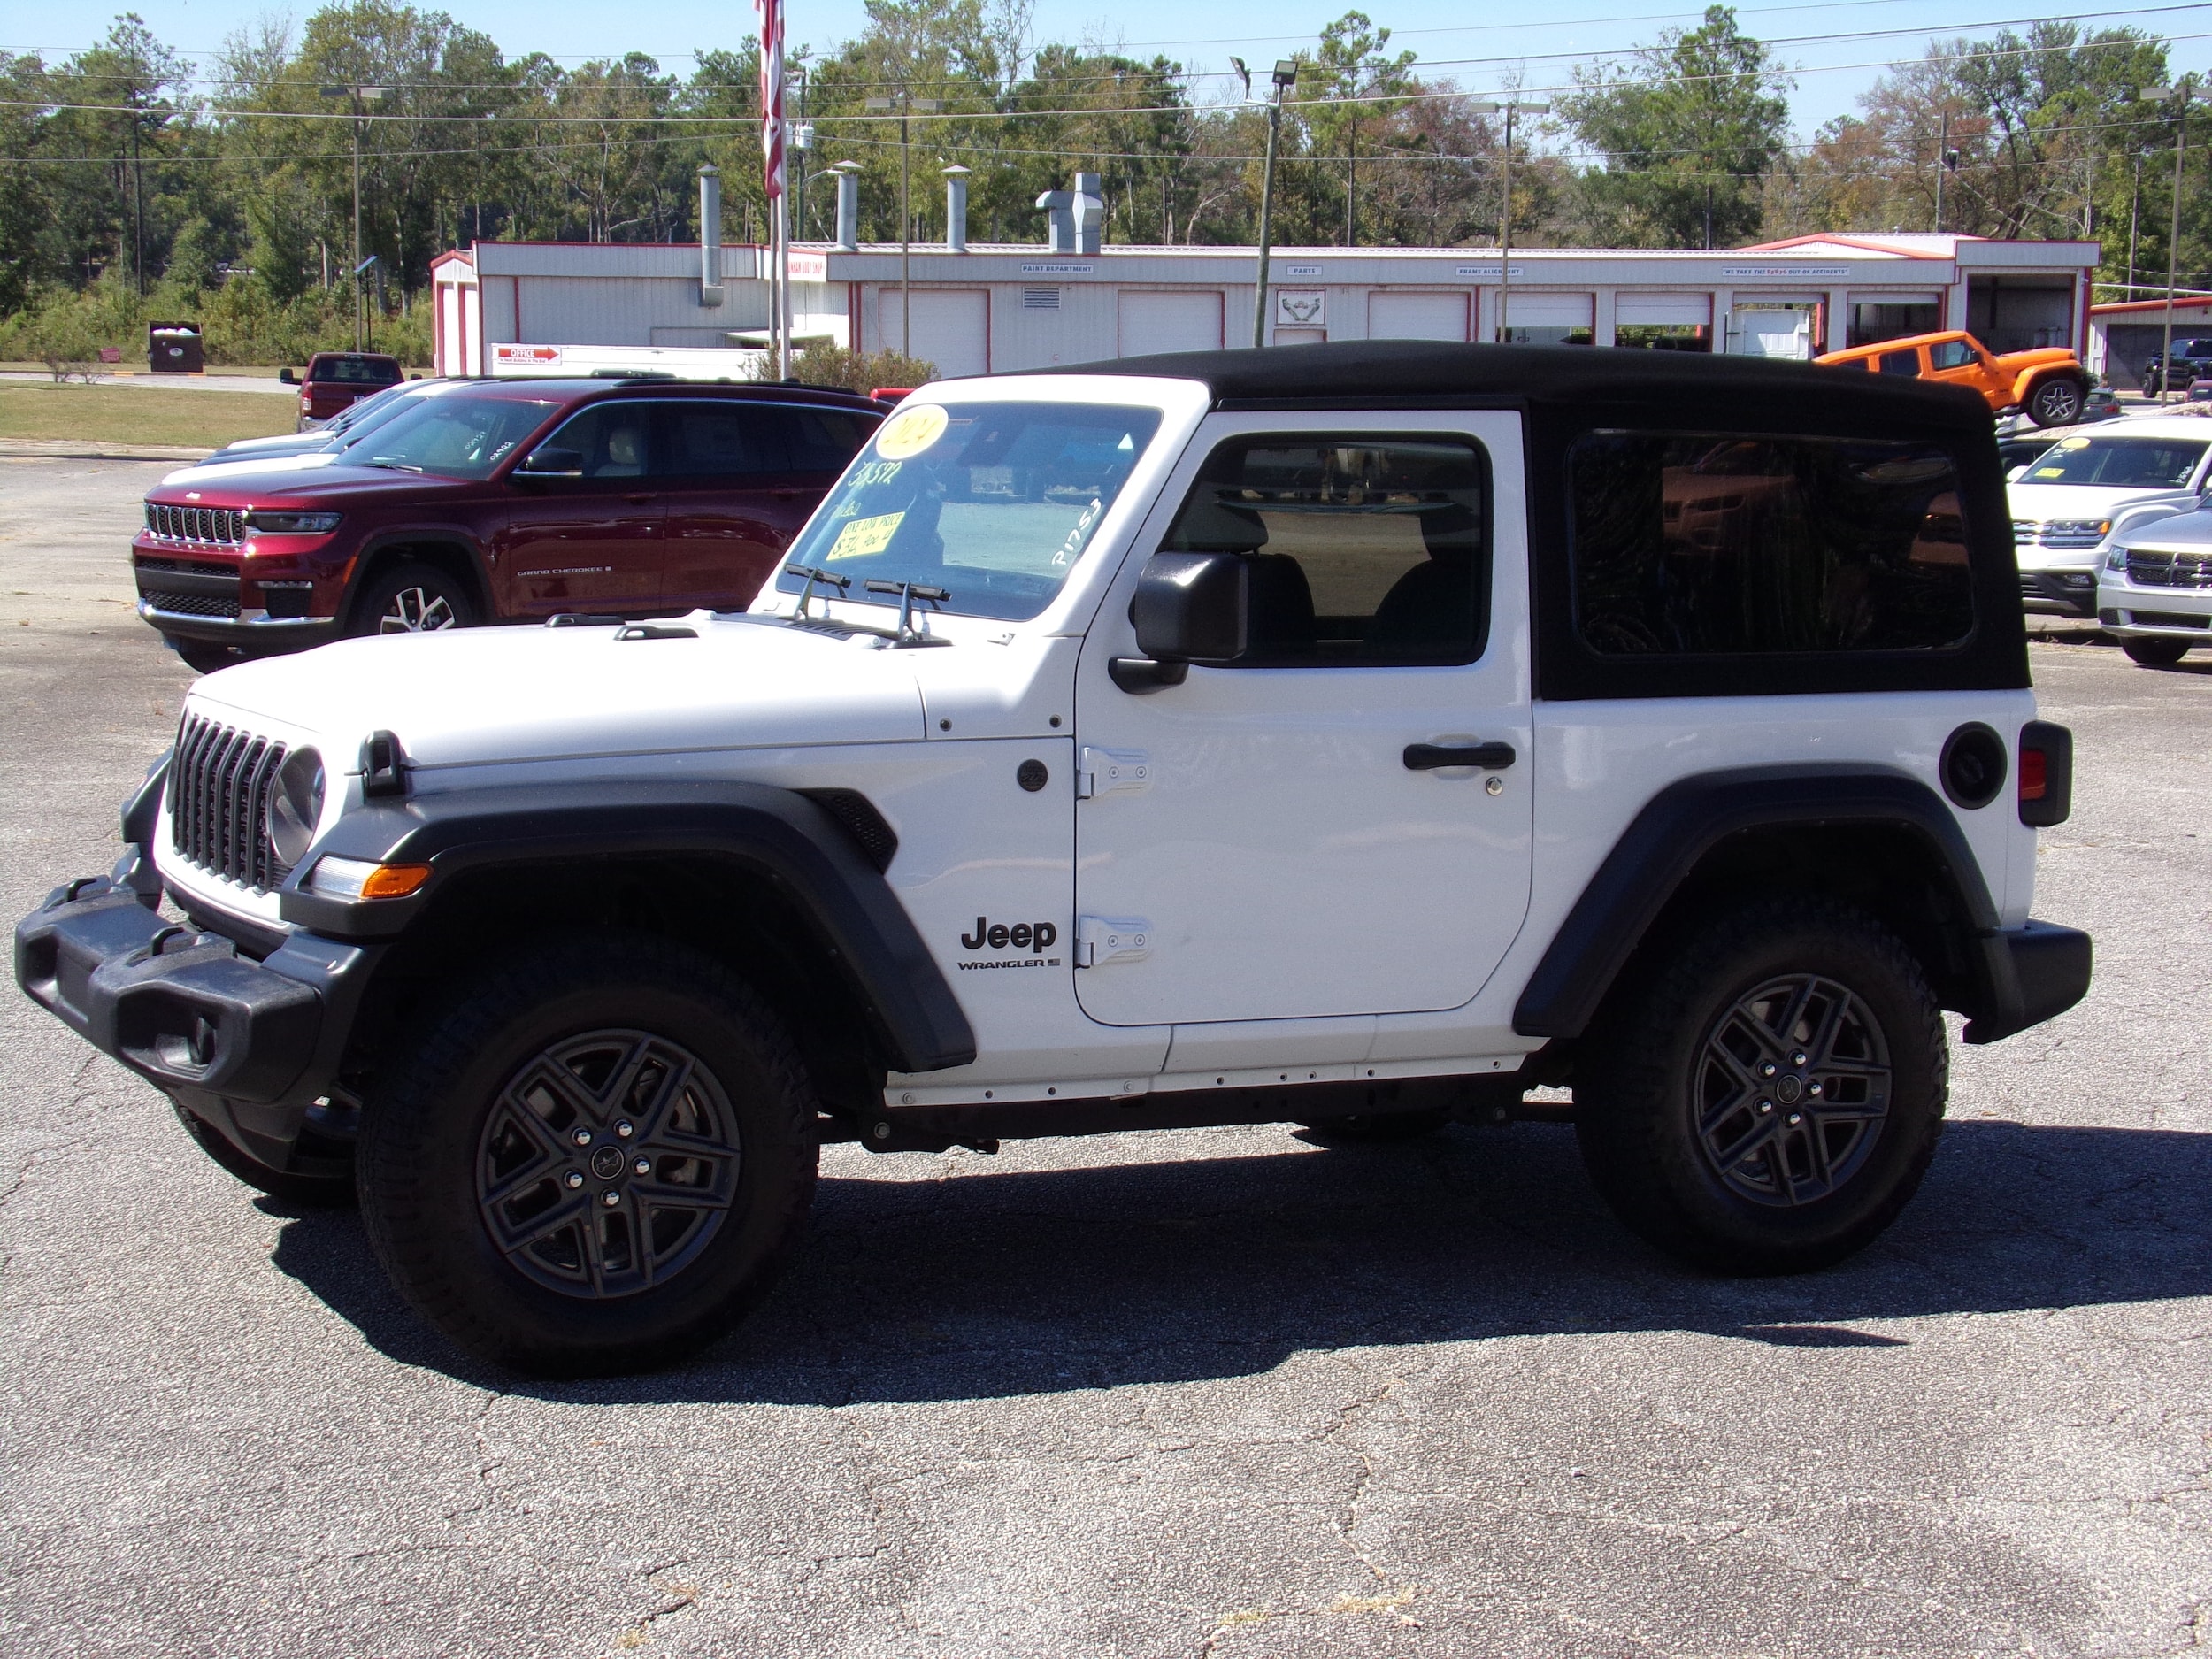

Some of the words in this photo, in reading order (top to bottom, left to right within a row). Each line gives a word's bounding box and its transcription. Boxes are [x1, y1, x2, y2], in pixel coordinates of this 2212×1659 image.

[510, 349, 535, 358] OFFICE
[845, 521, 862, 534] ONE
[861, 518, 880, 531] LOW
[879, 513, 902, 528] PRICE
[961, 916, 1056, 953] Jeep
[956, 959, 1044, 971] WRANGLER
